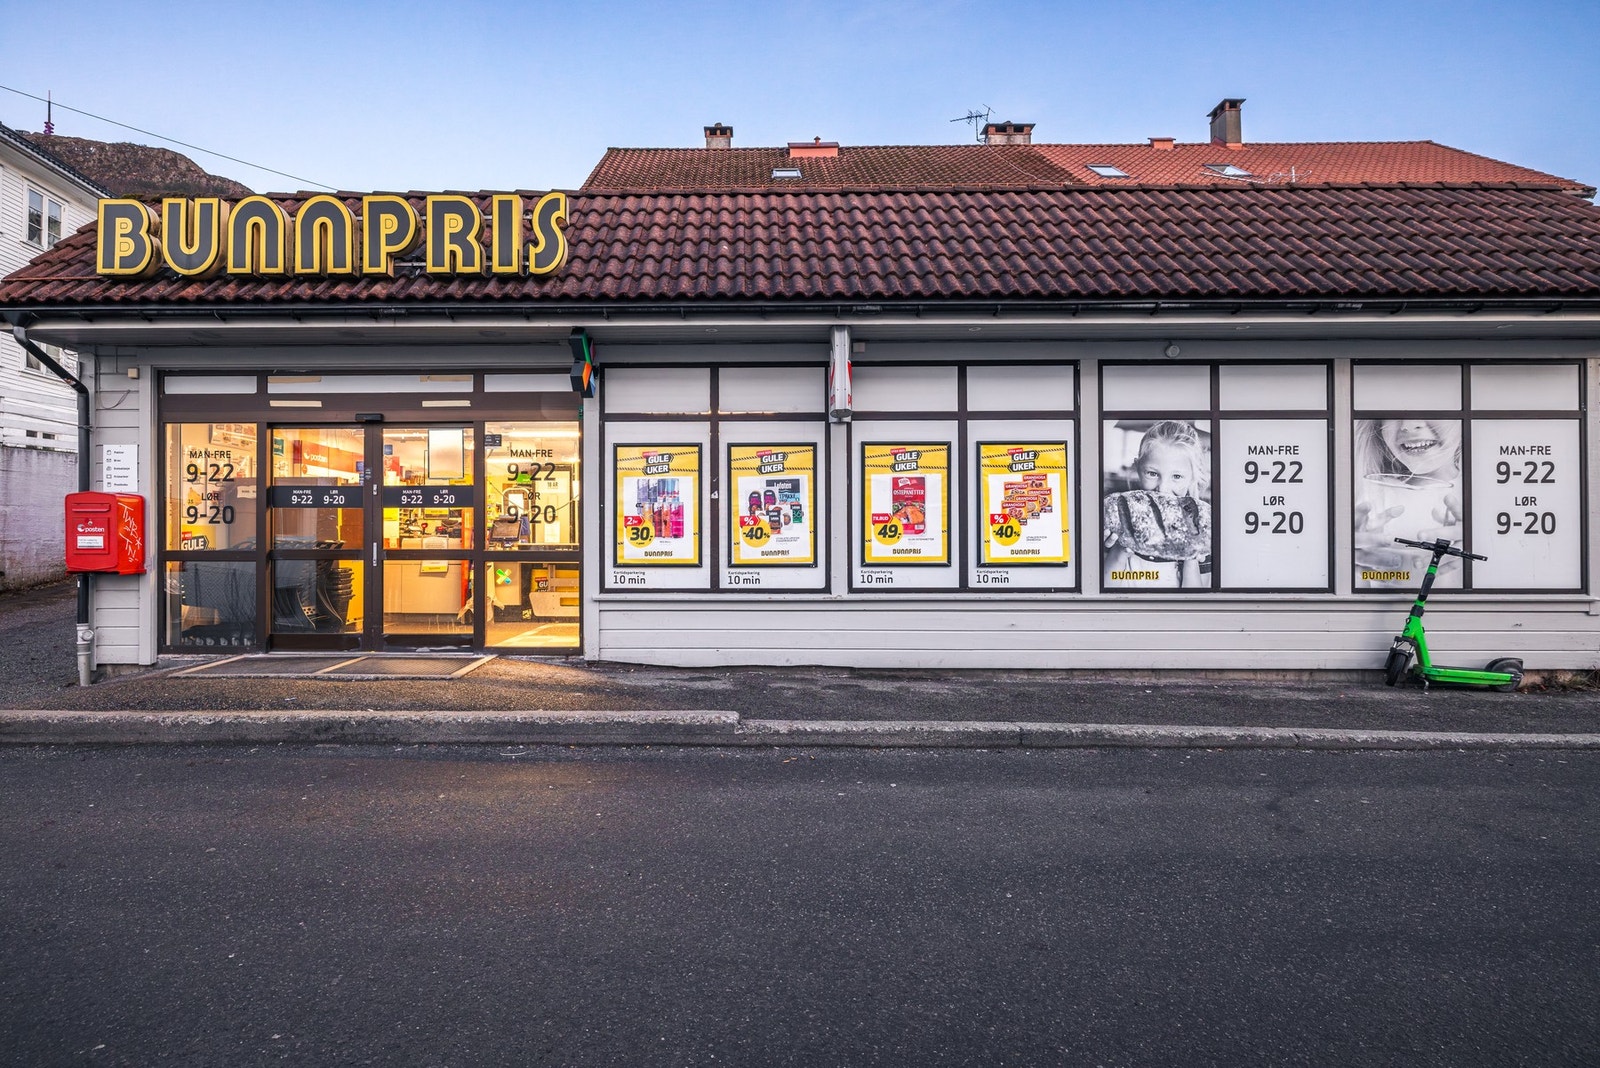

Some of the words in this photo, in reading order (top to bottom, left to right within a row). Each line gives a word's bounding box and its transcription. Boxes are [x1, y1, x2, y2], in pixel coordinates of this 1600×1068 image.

[97, 192, 569, 279] BUNNPRIS
[189, 450, 231, 459] MAN-FRE
[510, 449, 553, 458] MAN-FRE
[1248, 445, 1299, 455] MAN-FRE
[1499, 445, 1552, 455] MAN-FRE
[648, 454, 670, 464] GULE
[761, 453, 784, 463] GULE
[895, 451, 918, 461] GULE
[1013, 451, 1035, 461] GULE
[507, 462, 556, 481] 9-22
[646, 465, 669, 475] UKER
[760, 464, 784, 474] UKER
[895, 462, 917, 471] UKER
[1012, 461, 1035, 472] UKER
[186, 463, 235, 482] 9-22
[1244, 460, 1304, 484] 9-22
[1496, 460, 1556, 484] 9-22
[201, 492, 219, 501] LØR
[291, 495, 313, 504] 9-22
[323, 495, 345, 505] 9-20
[401, 495, 423, 504] 9-22
[433, 495, 455, 505] 9-20
[1263, 495, 1285, 506] LØR
[1514, 496, 1537, 506] LØR
[186, 505, 235, 524] 9-20
[507, 504, 556, 524] 9-20
[993, 514, 1004, 524] %
[626, 517, 633, 525] 2
[743, 516, 754, 526] %
[1244, 511, 1304, 534] 9-20
[1496, 511, 1556, 535] 9-20
[181, 537, 204, 551] GULE
[613, 575, 626, 585] 10
[628, 575, 646, 585] min
[727, 575, 740, 585] 10
[742, 575, 761, 585] min
[860, 574, 873, 584] 10
[875, 574, 894, 584] min
[976, 574, 989, 584] 10
[991, 574, 1010, 584] min
[1111, 570, 1159, 580] BUNNPRIS
[1362, 571, 1410, 580] BUNNPRIS
